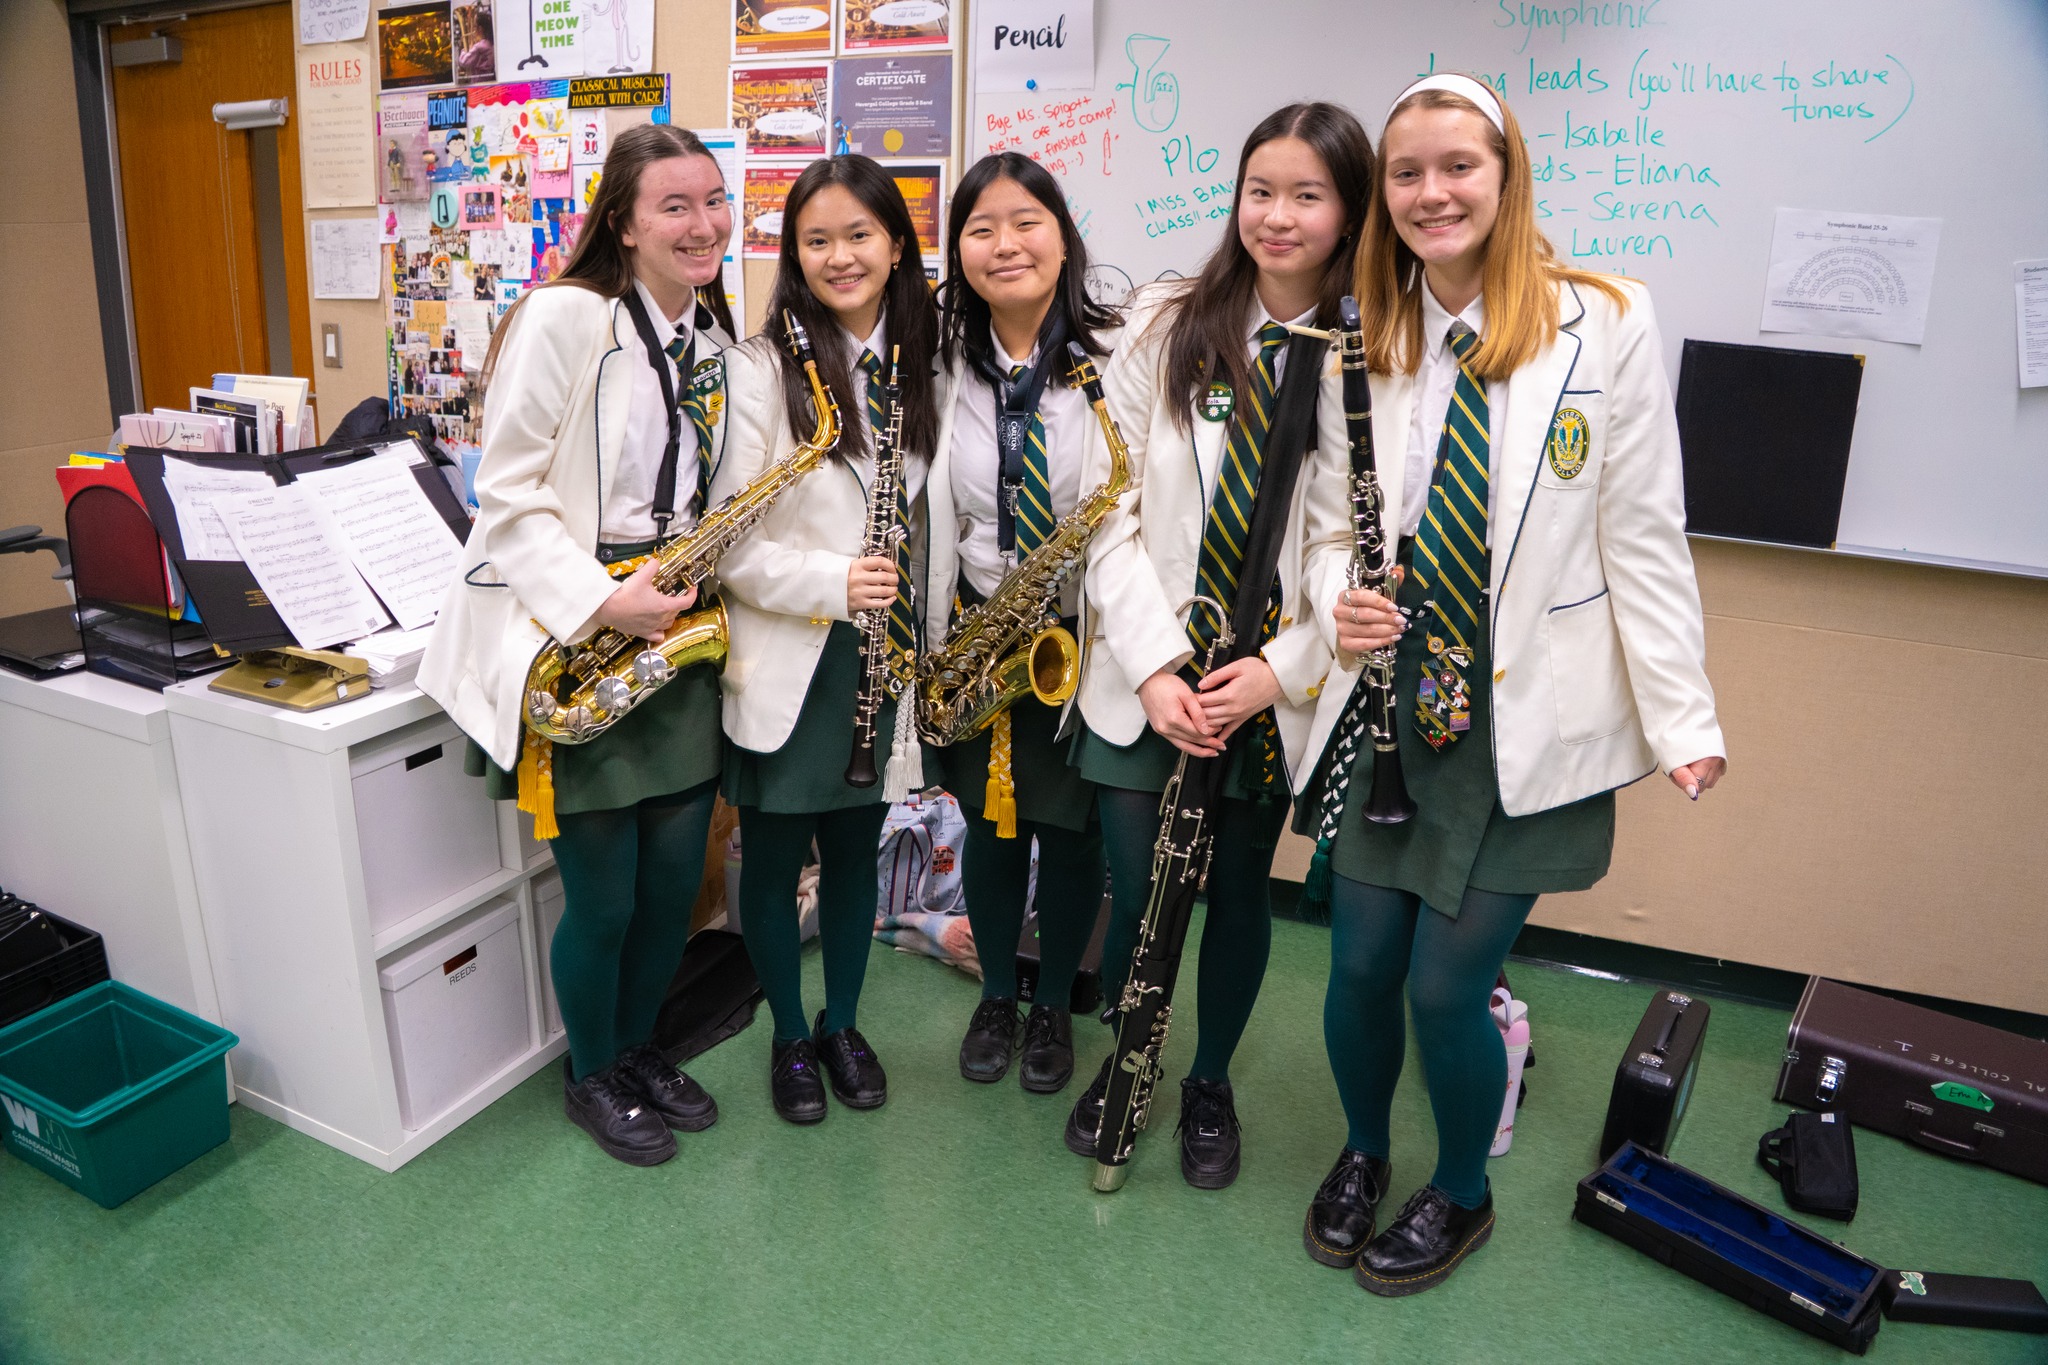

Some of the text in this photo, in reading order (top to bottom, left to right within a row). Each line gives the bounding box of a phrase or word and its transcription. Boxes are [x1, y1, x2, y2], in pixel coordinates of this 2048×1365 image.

[543, 0, 571, 14] ONE
[536, 16, 579, 32] MEOW
[995, 14, 1067, 50] Pencil
[1494, 0, 1667, 54] Symphonic
[540, 34, 574, 48] TIME
[309, 59, 361, 81] RULES
[856, 74, 926, 86] CERTIFICATE
[1529, 58, 1608, 95] leads
[1706, 62, 1767, 93] have
[1772, 60, 1800, 92] to
[1812, 60, 1889, 88] share
[570, 76, 665, 93] CLASSICAL MUSICIAN
[428, 95, 467, 126] PEANUTS
[572, 90, 661, 107] HANDEL WITH CARE
[1079, 98, 1117, 126] camp!
[384, 110, 425, 122] Beethoven
[987, 96, 1092, 135] Bye Ms. Spigott
[1564, 110, 1666, 149] Isabelle
[1045, 130, 1087, 157] finished
[1614, 153, 1721, 187] Eliana
[1147, 194, 1187, 214] MISS
[1193, 179, 1237, 203] BAN
[1589, 191, 1719, 227] Serena
[1827, 221, 1857, 230] Symphonic
[1572, 228, 1673, 259] Lauren
[695, 369, 717, 382] Lauren
[1553, 411, 1585, 429] HAVERGAL
[1010, 421, 1018, 451] CARLTON
[1553, 460, 1583, 476] COLLEGE
[449, 962, 477, 986] REEDS
[1930, 1053, 2010, 1082] COLLEGE
[12, 1130, 81, 1174] CANADIAN WASTE
